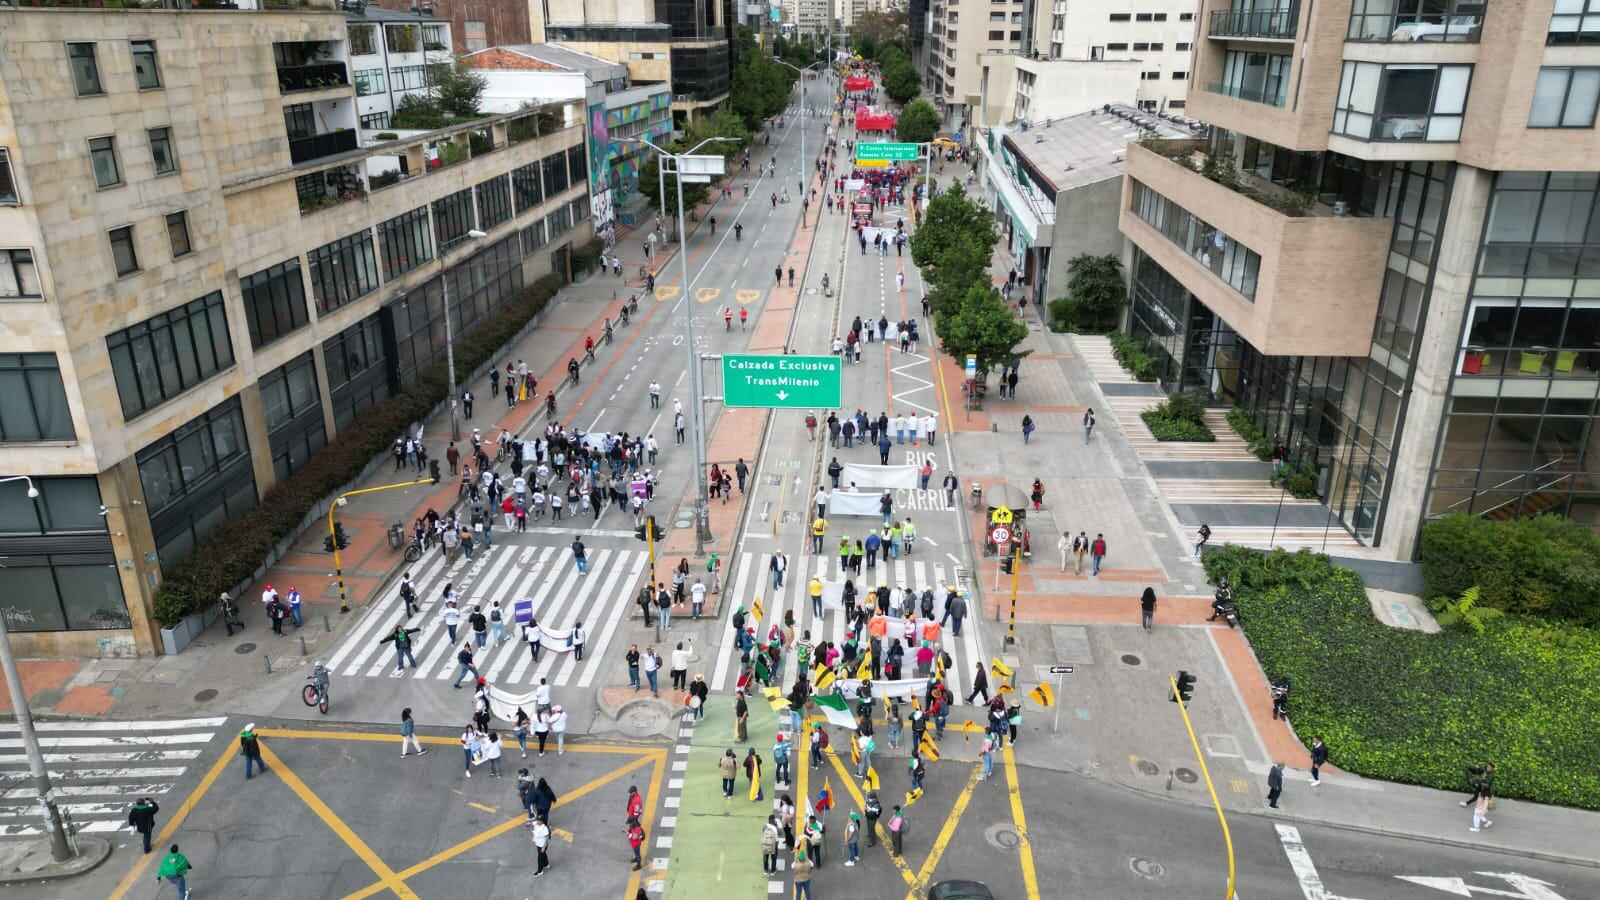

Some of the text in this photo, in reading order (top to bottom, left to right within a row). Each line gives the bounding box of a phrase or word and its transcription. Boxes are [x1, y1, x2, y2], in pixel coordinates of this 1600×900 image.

[729, 359, 835, 371] Calzada Exclusiva
[745, 375, 819, 387] TransMilenio
[906, 450, 937, 470] BUS
[896, 488, 956, 511] CARRIL
[995, 531, 1007, 539] 30
